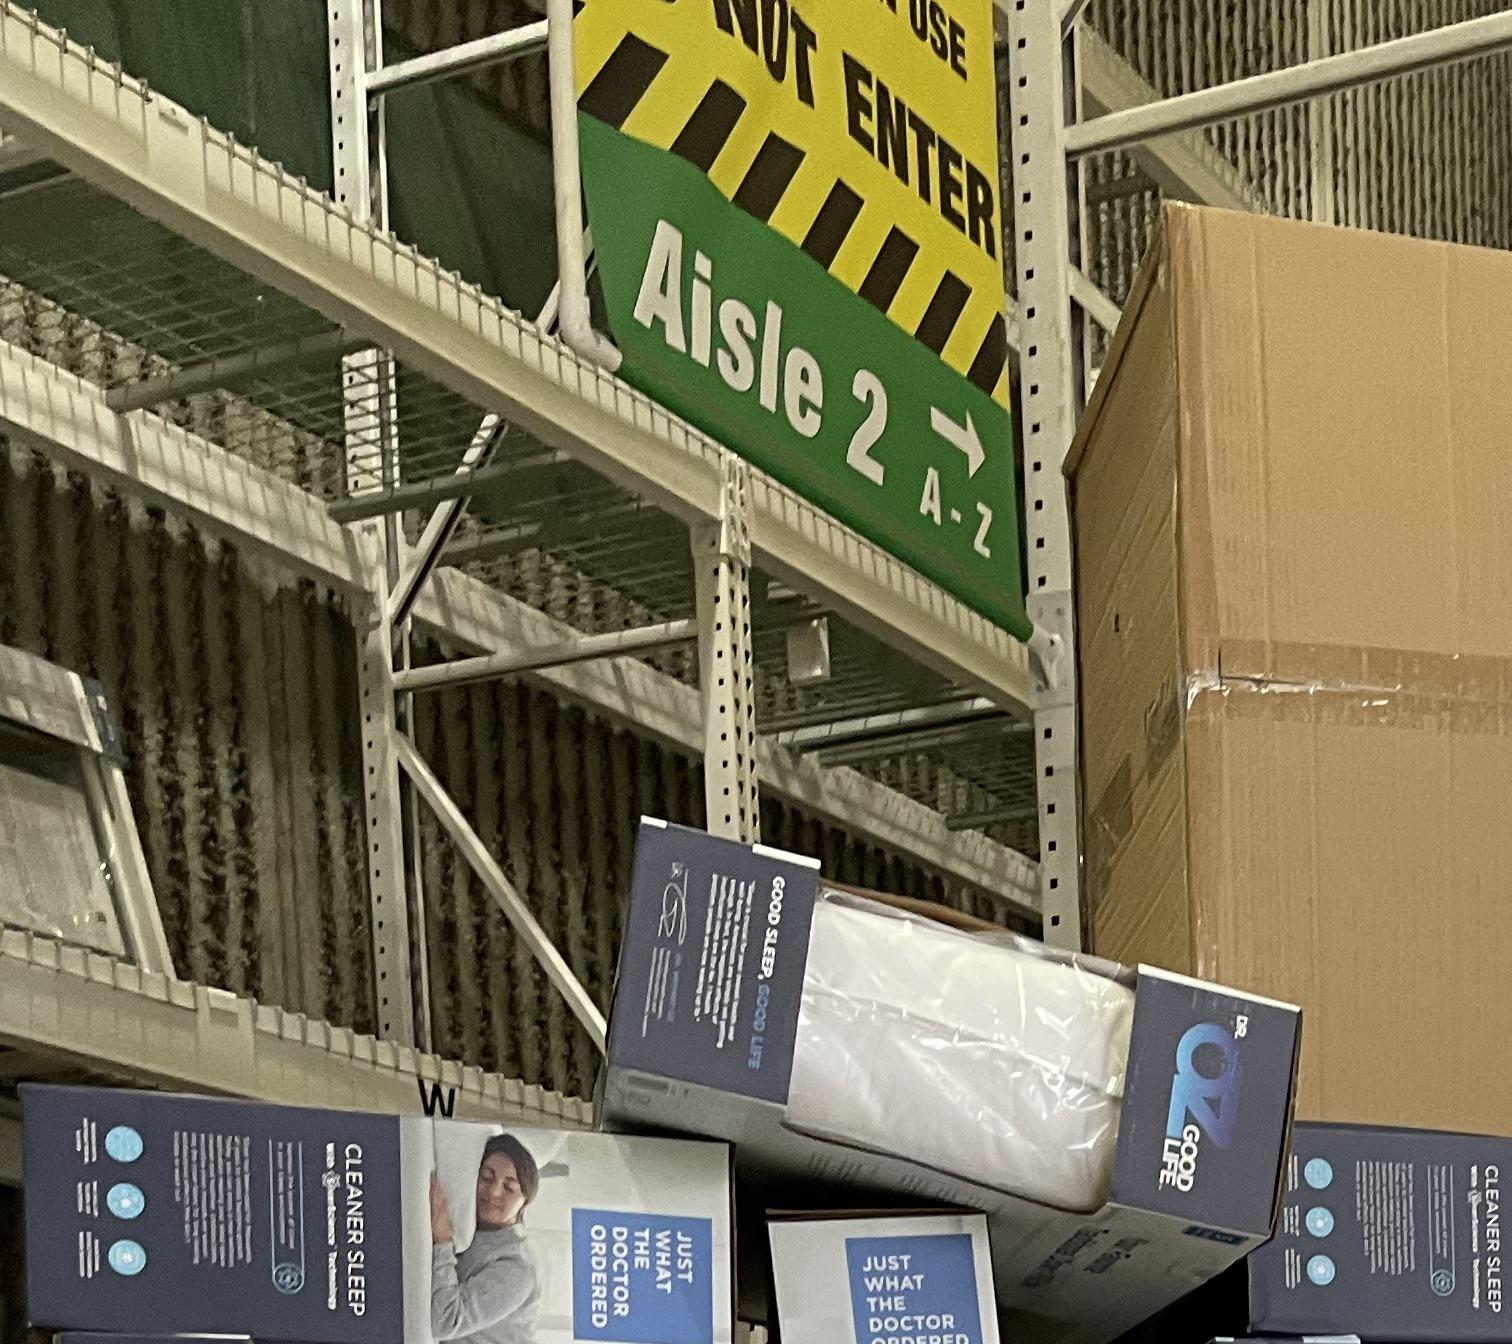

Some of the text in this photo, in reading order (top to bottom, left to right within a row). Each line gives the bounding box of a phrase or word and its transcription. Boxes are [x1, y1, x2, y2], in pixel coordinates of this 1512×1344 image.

[842, 49, 997, 261] ENTER
[633, 219, 889, 487] Aisle 2
[920, 467, 942, 526] A
[974, 501, 993, 558] Z
[768, 876, 786, 926] GOOD
[754, 984, 770, 1032] GOOD
[345, 1143, 366, 1316] CLEANER SLEEP
[634, 1228, 650, 1270] THE
[590, 1224, 608, 1328] ORDERED
[612, 1226, 629, 1316] DOCTOR
[655, 1230, 672, 1294] WHAT
[676, 1230, 693, 1284] JUST
[862, 1254, 912, 1272] JUST
[864, 1274, 925, 1292] WHAT
[866, 1295, 906, 1313] THE
[869, 1314, 954, 1333] DOCTOR
